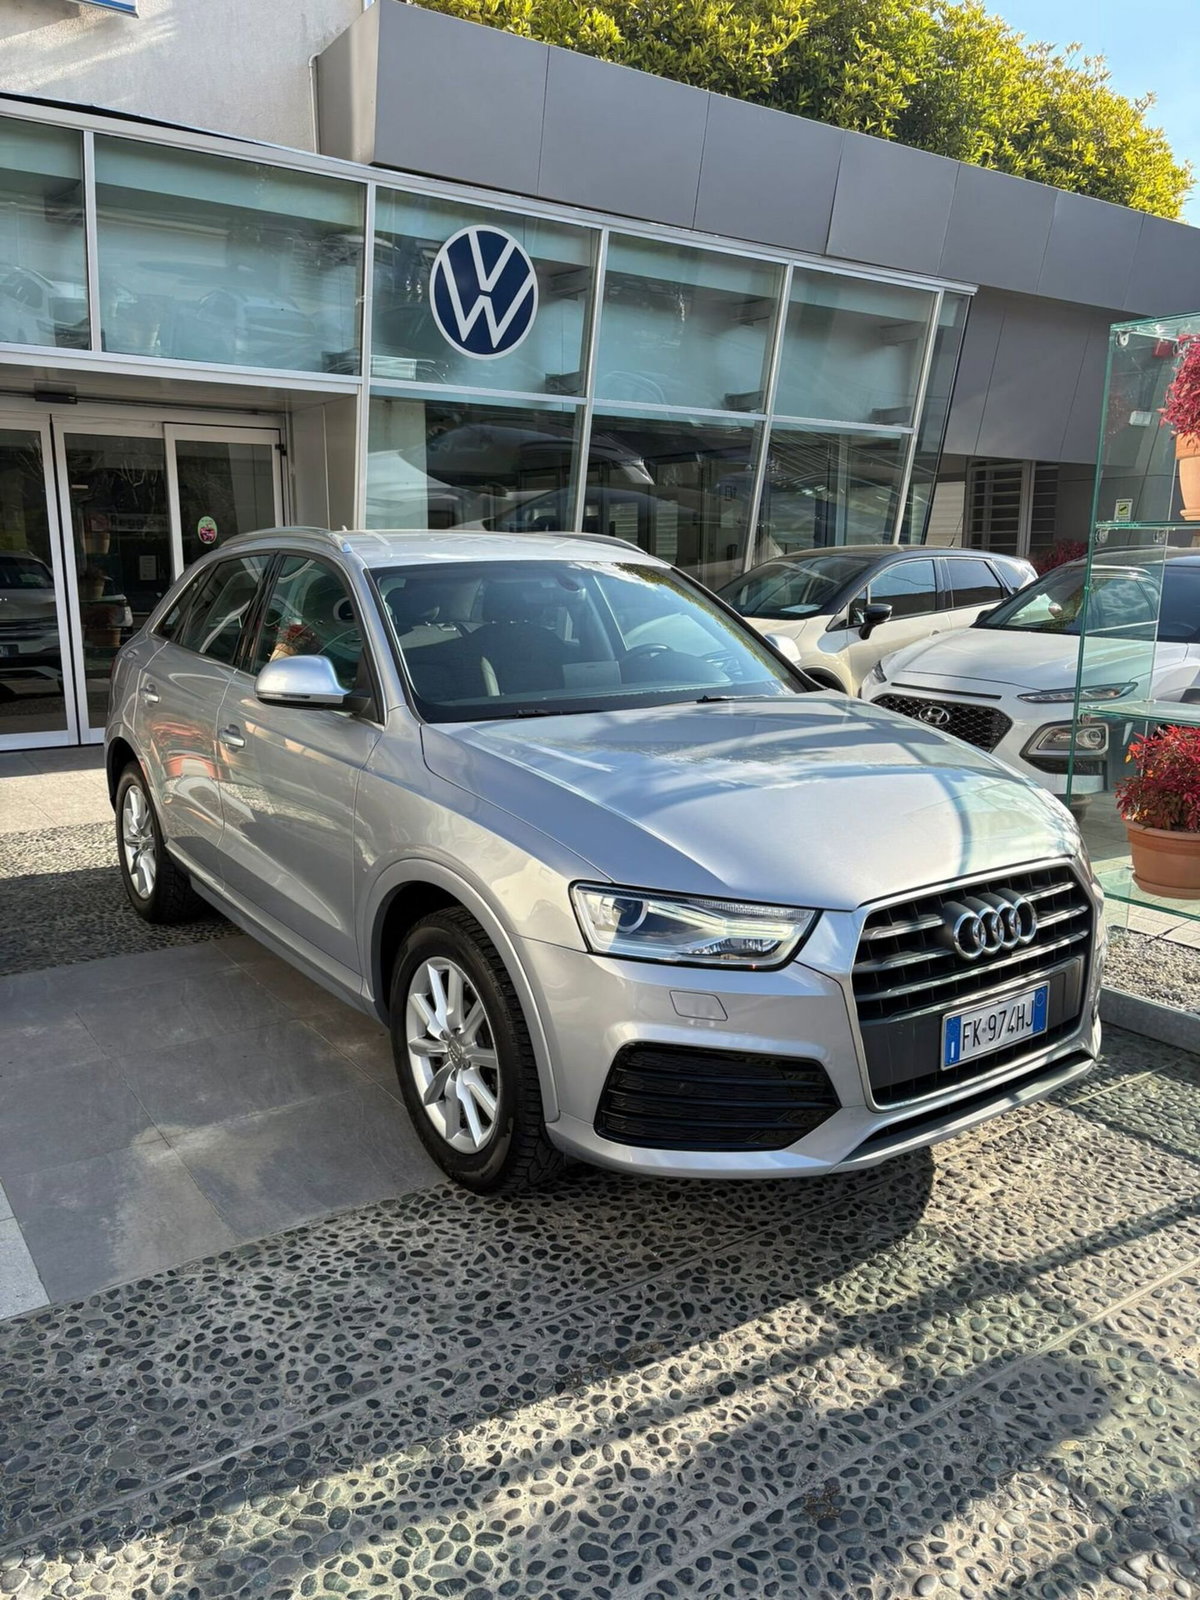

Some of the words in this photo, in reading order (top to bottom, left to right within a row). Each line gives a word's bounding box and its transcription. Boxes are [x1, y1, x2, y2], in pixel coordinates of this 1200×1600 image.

[436, 228, 536, 350] VW
[962, 1018, 983, 1052] FK
[988, 1000, 1034, 1041] 974HJ
